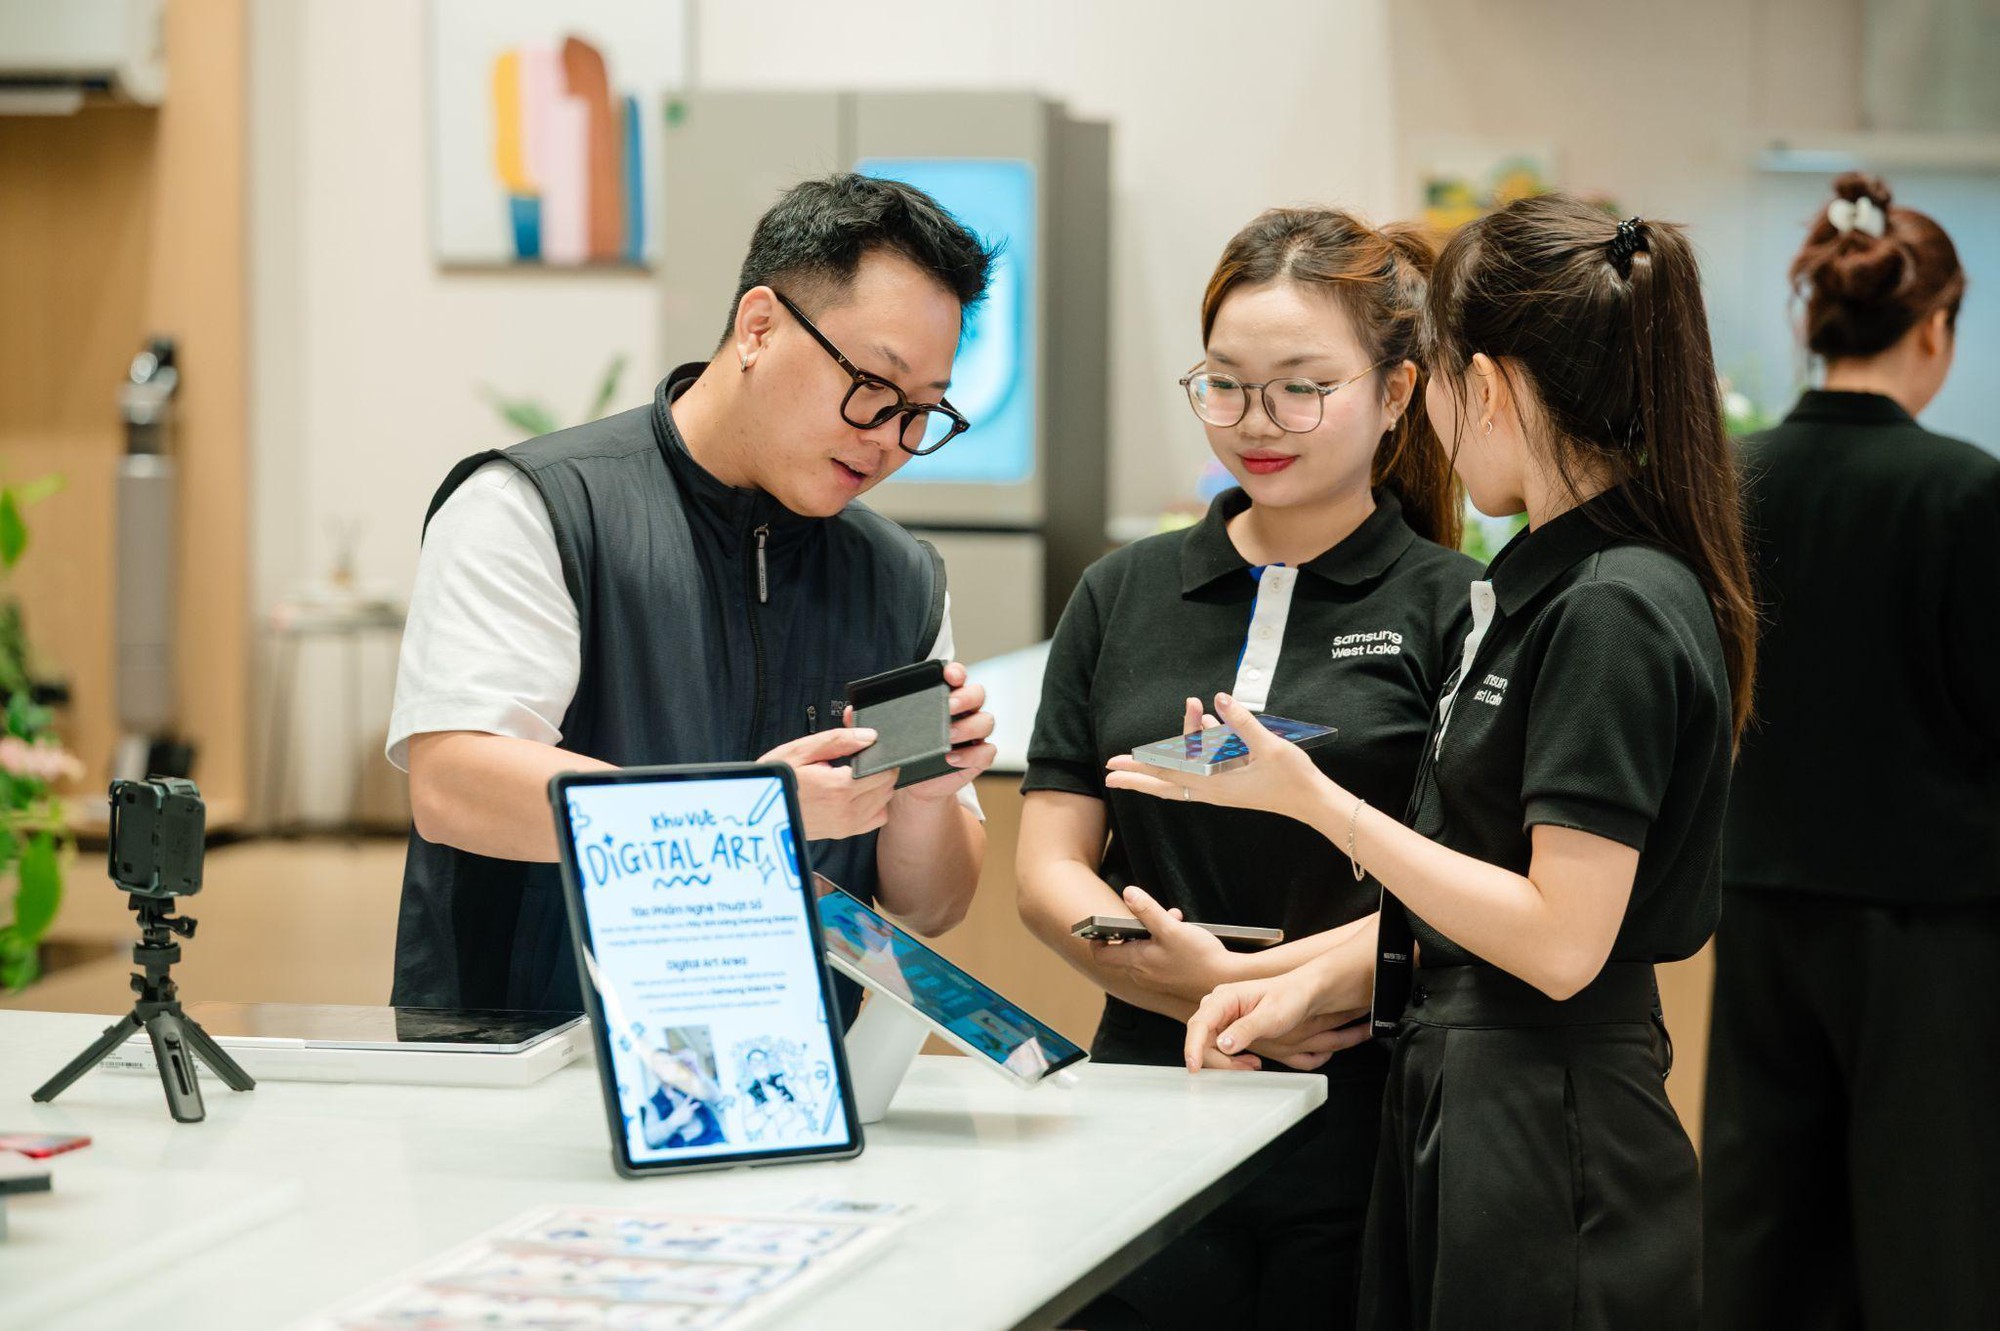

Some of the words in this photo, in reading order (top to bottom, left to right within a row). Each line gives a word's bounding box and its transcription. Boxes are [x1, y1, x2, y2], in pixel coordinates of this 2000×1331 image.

[1333, 630, 1403, 646] samsung
[1331, 647, 1364, 659] West
[1366, 642, 1401, 655] Lake
[711, 832, 764, 870] ART
